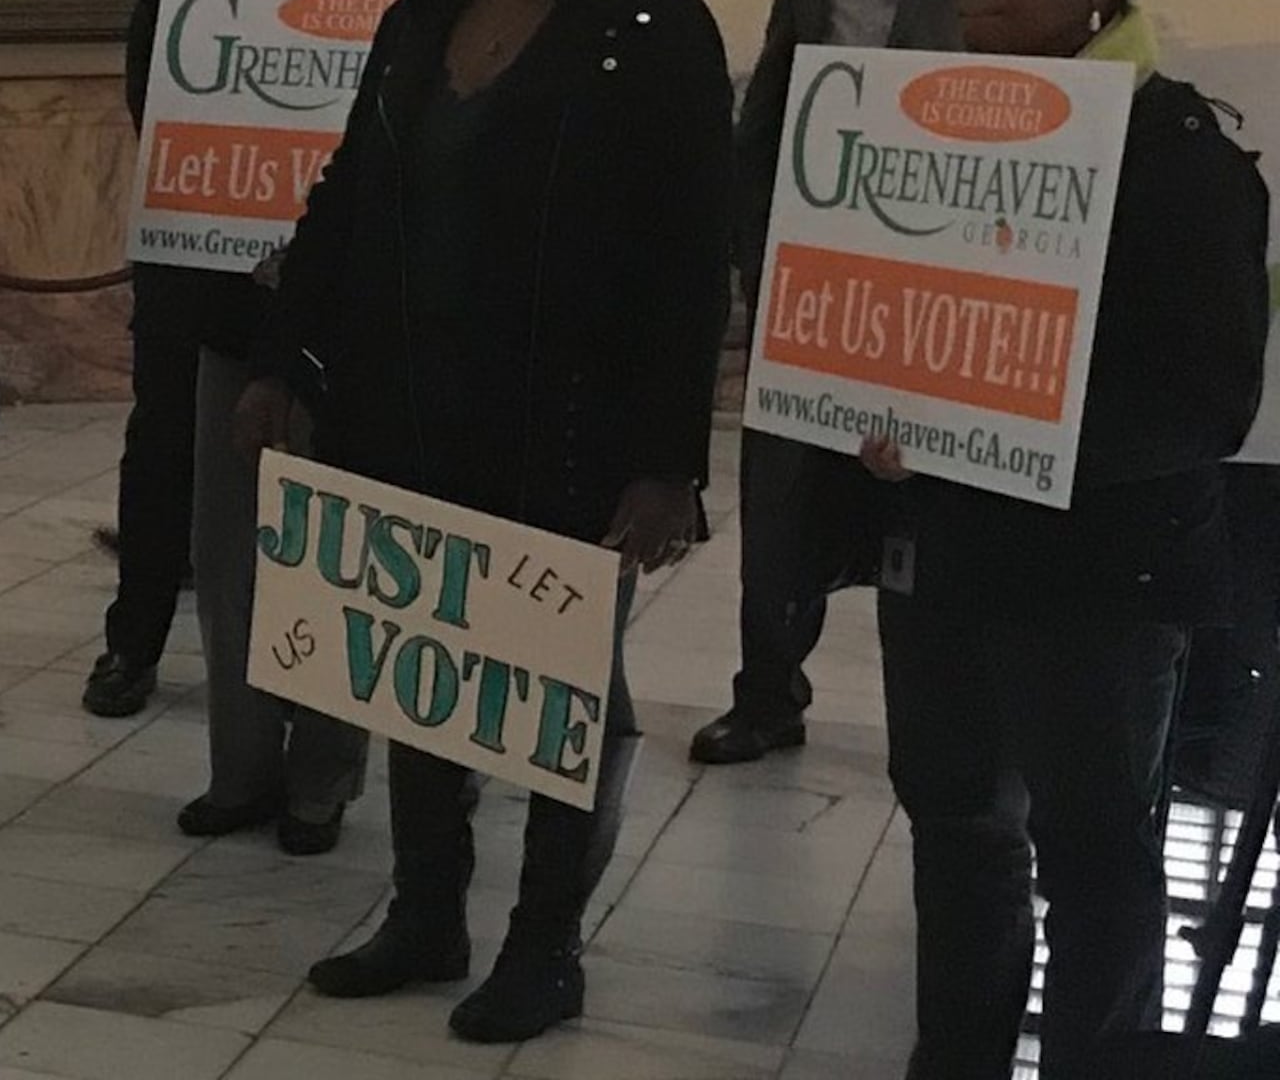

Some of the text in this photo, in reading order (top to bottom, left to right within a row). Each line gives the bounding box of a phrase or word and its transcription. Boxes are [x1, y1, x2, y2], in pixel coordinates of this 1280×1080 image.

[302, 13, 322, 28] IS
[922, 101, 1043, 134] IS COMING!
[935, 77, 1040, 107] THE CITY
[154, 138, 219, 198] Let
[228, 144, 279, 201] Us
[771, 266, 1068, 395] Let Us VOTE!!!
[757, 383, 1057, 492] www.Greenhaven-GA.org
[256, 477, 585, 630] JUST LET
[270, 605, 601, 784] US VOTE
